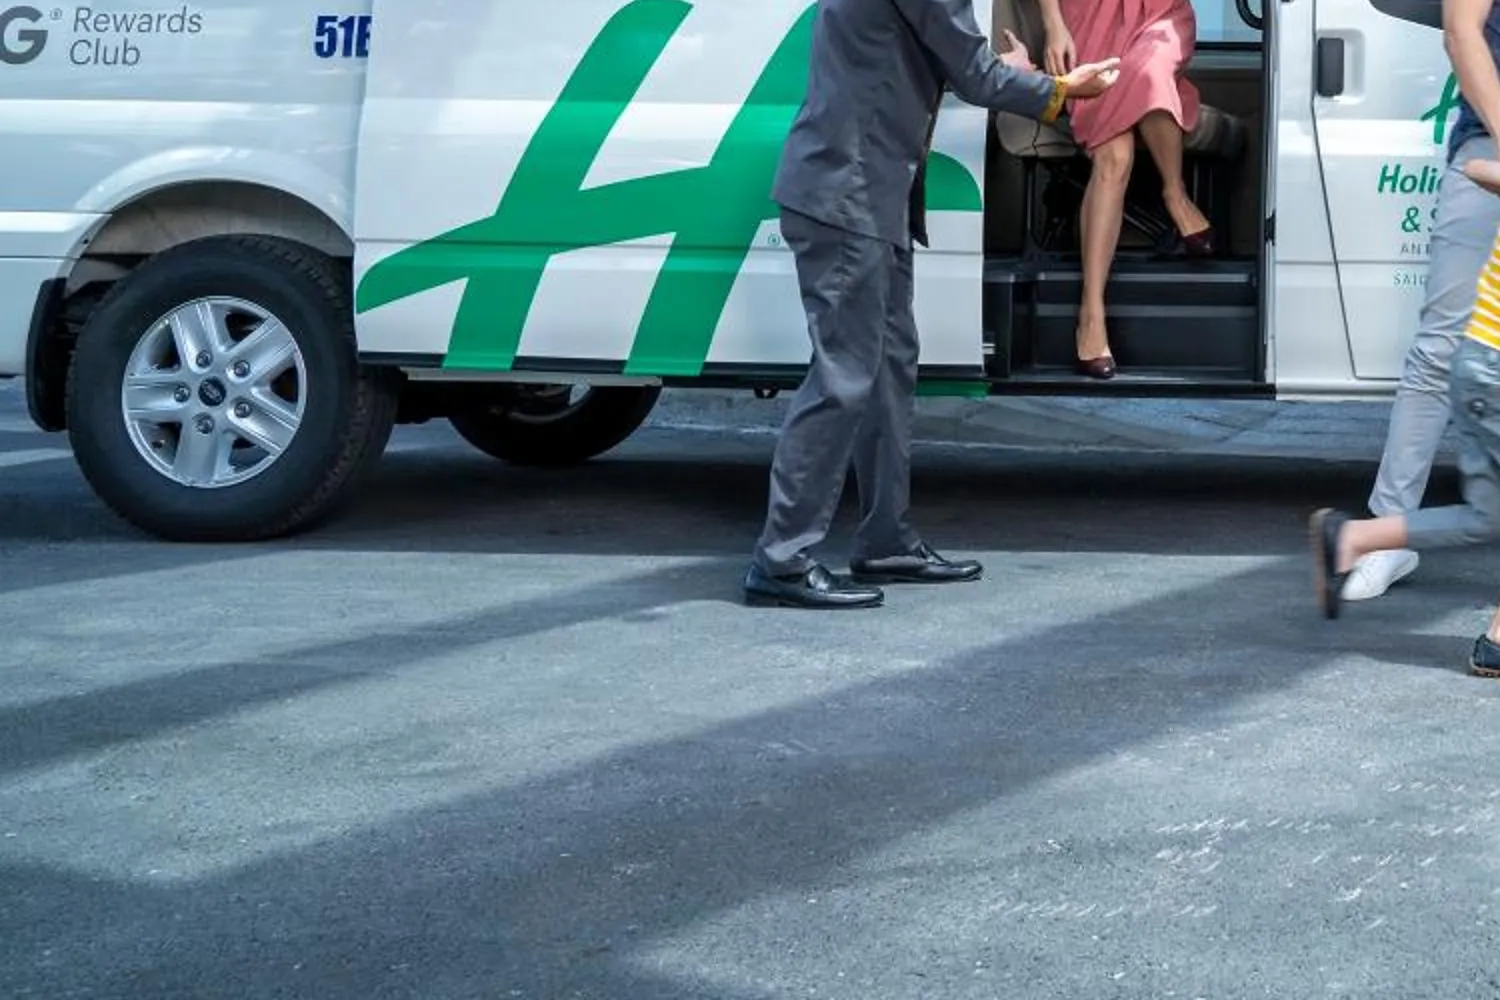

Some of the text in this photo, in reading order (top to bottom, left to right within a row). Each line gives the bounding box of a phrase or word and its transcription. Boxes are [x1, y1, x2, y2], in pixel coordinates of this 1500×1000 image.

[73, 5, 202, 33] Rewards
[70, 38, 141, 65] Club
[1377, 163, 1441, 193] Holi
[1401, 206, 1421, 232] &
